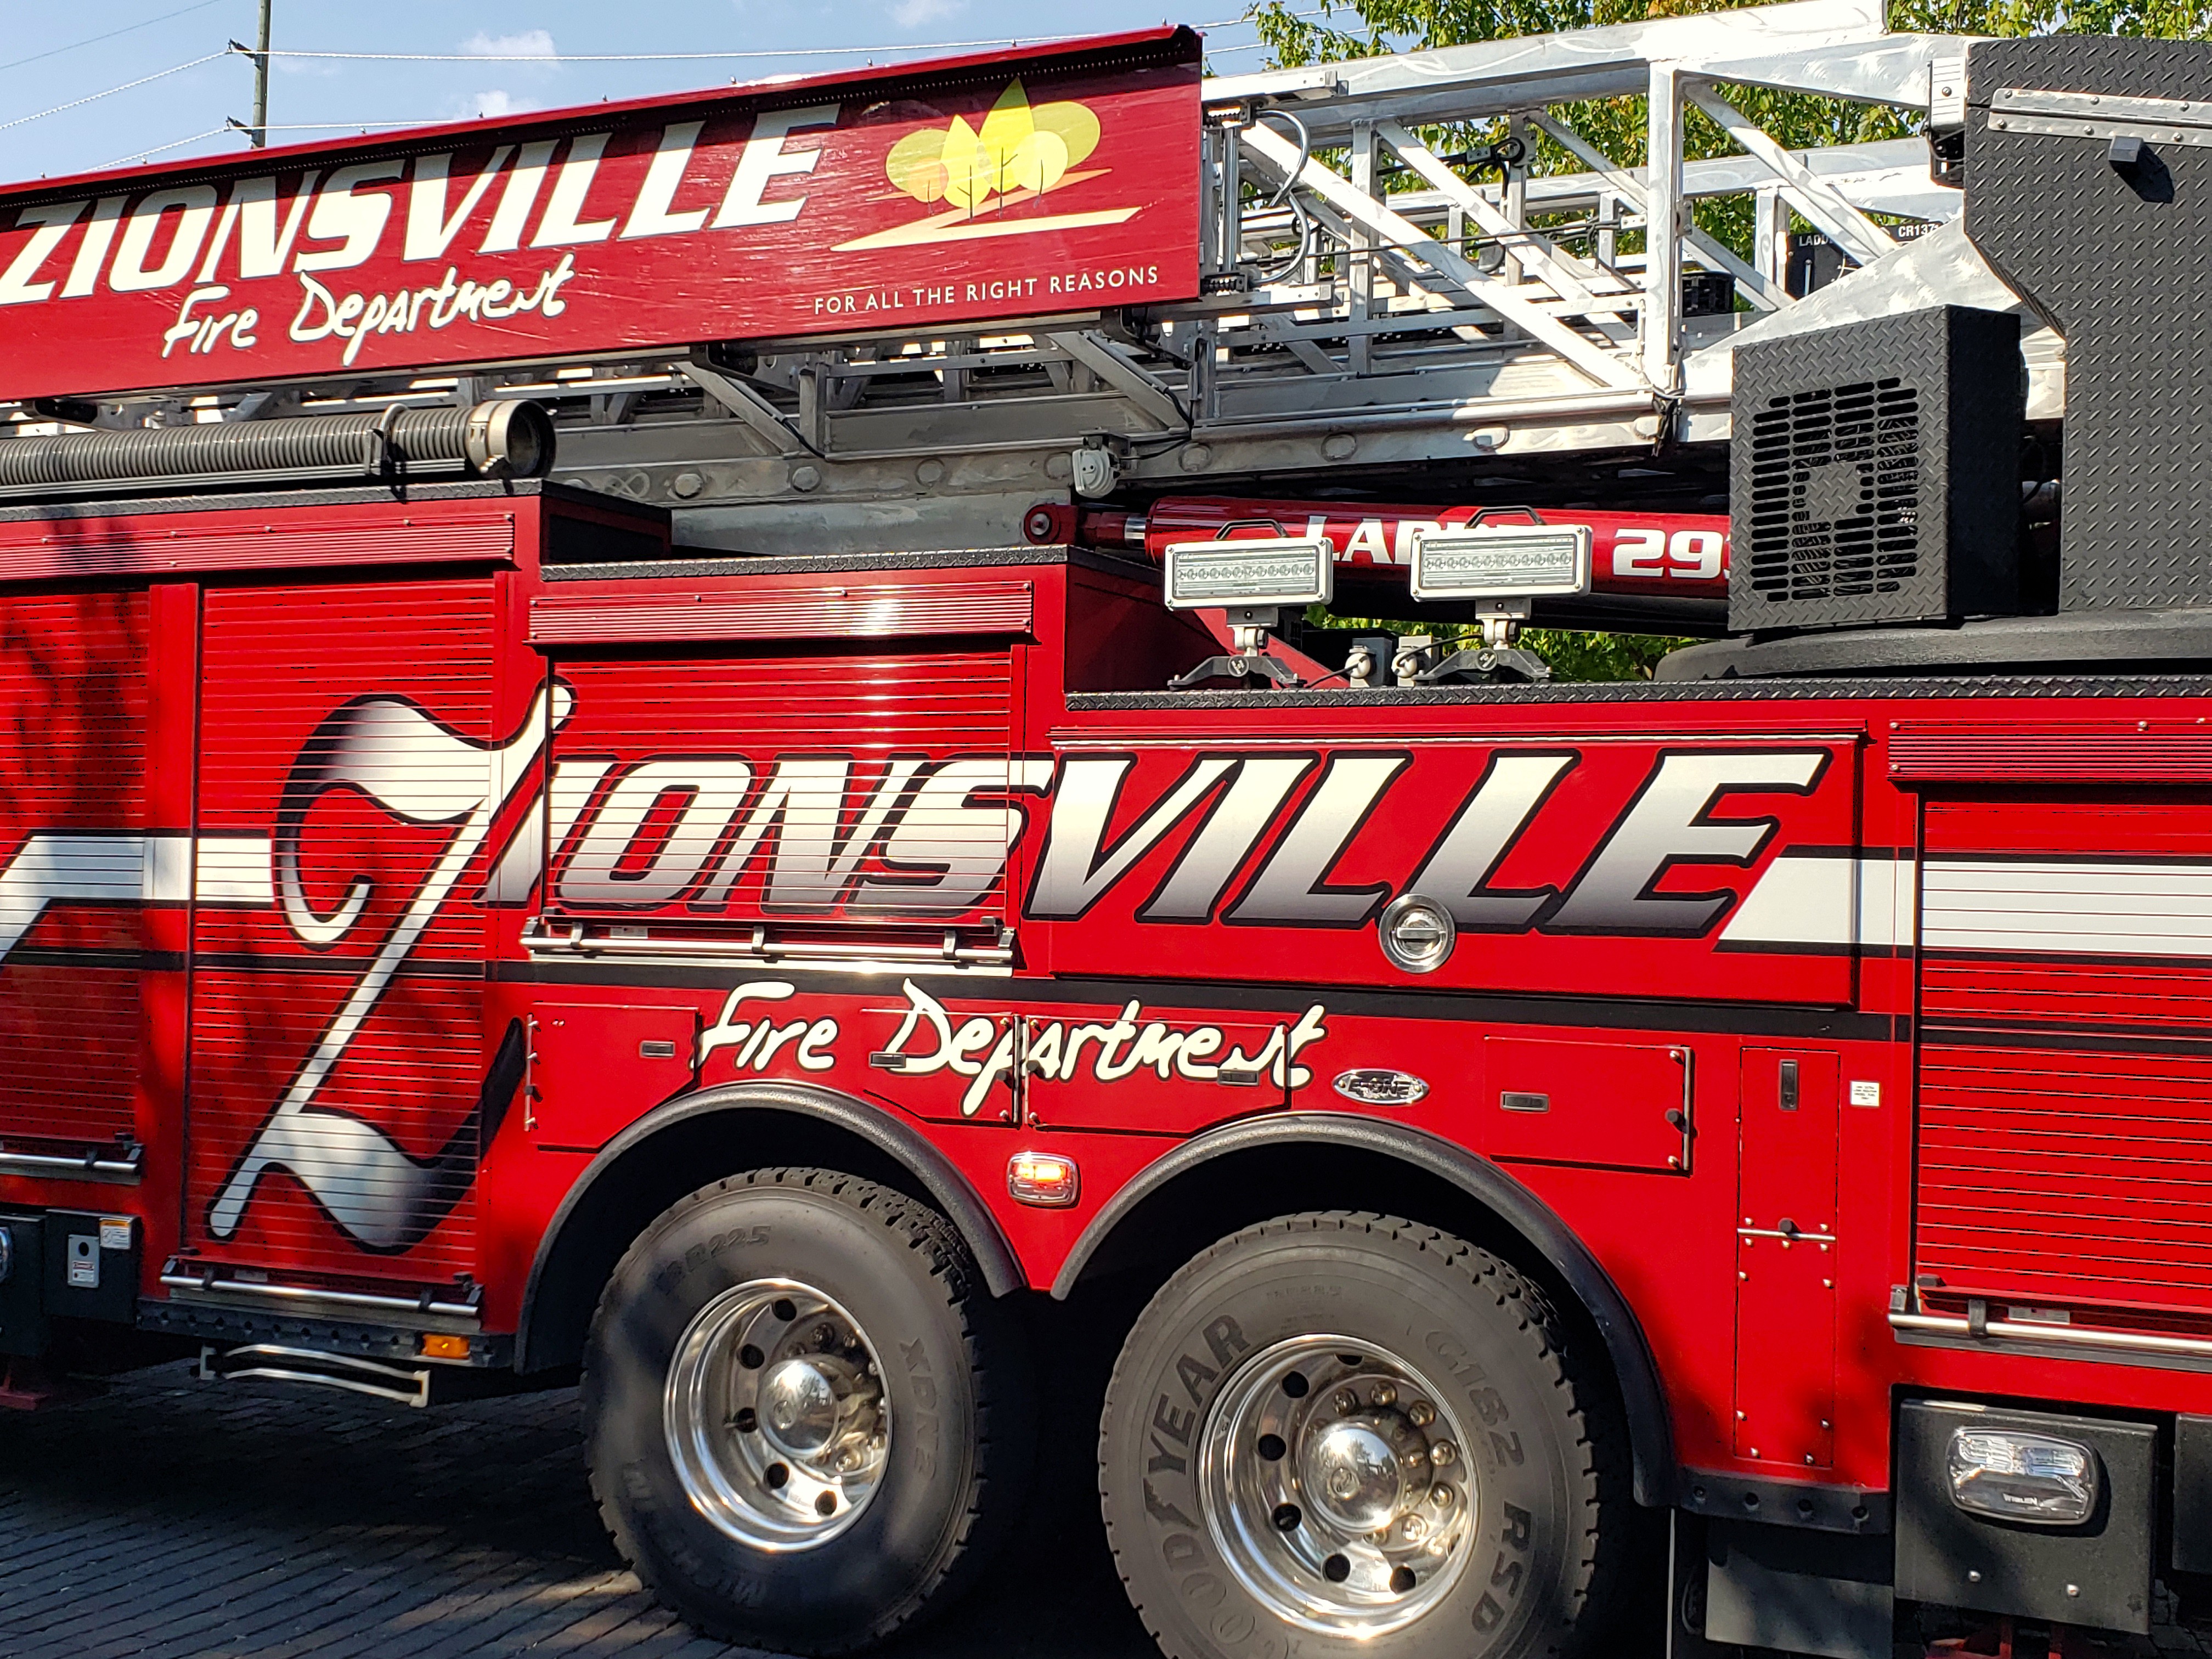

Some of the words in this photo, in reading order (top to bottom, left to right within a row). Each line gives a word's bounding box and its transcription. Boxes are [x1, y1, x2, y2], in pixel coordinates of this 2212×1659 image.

[0, 103, 840, 305] ZIONSVILLE
[162, 286, 258, 359] Fire
[289, 252, 575, 366] Department
[815, 296, 856, 315] FOR
[865, 292, 904, 311] ALL
[912, 286, 955, 306] THE
[966, 278, 1037, 302] RIGHT
[1049, 267, 1159, 294] REASONS
[1613, 528, 1730, 579] 29
[697, 980, 838, 1073] Fire
[880, 977, 1328, 1118] Department
[1471, 1500, 1532, 1635] RSD
